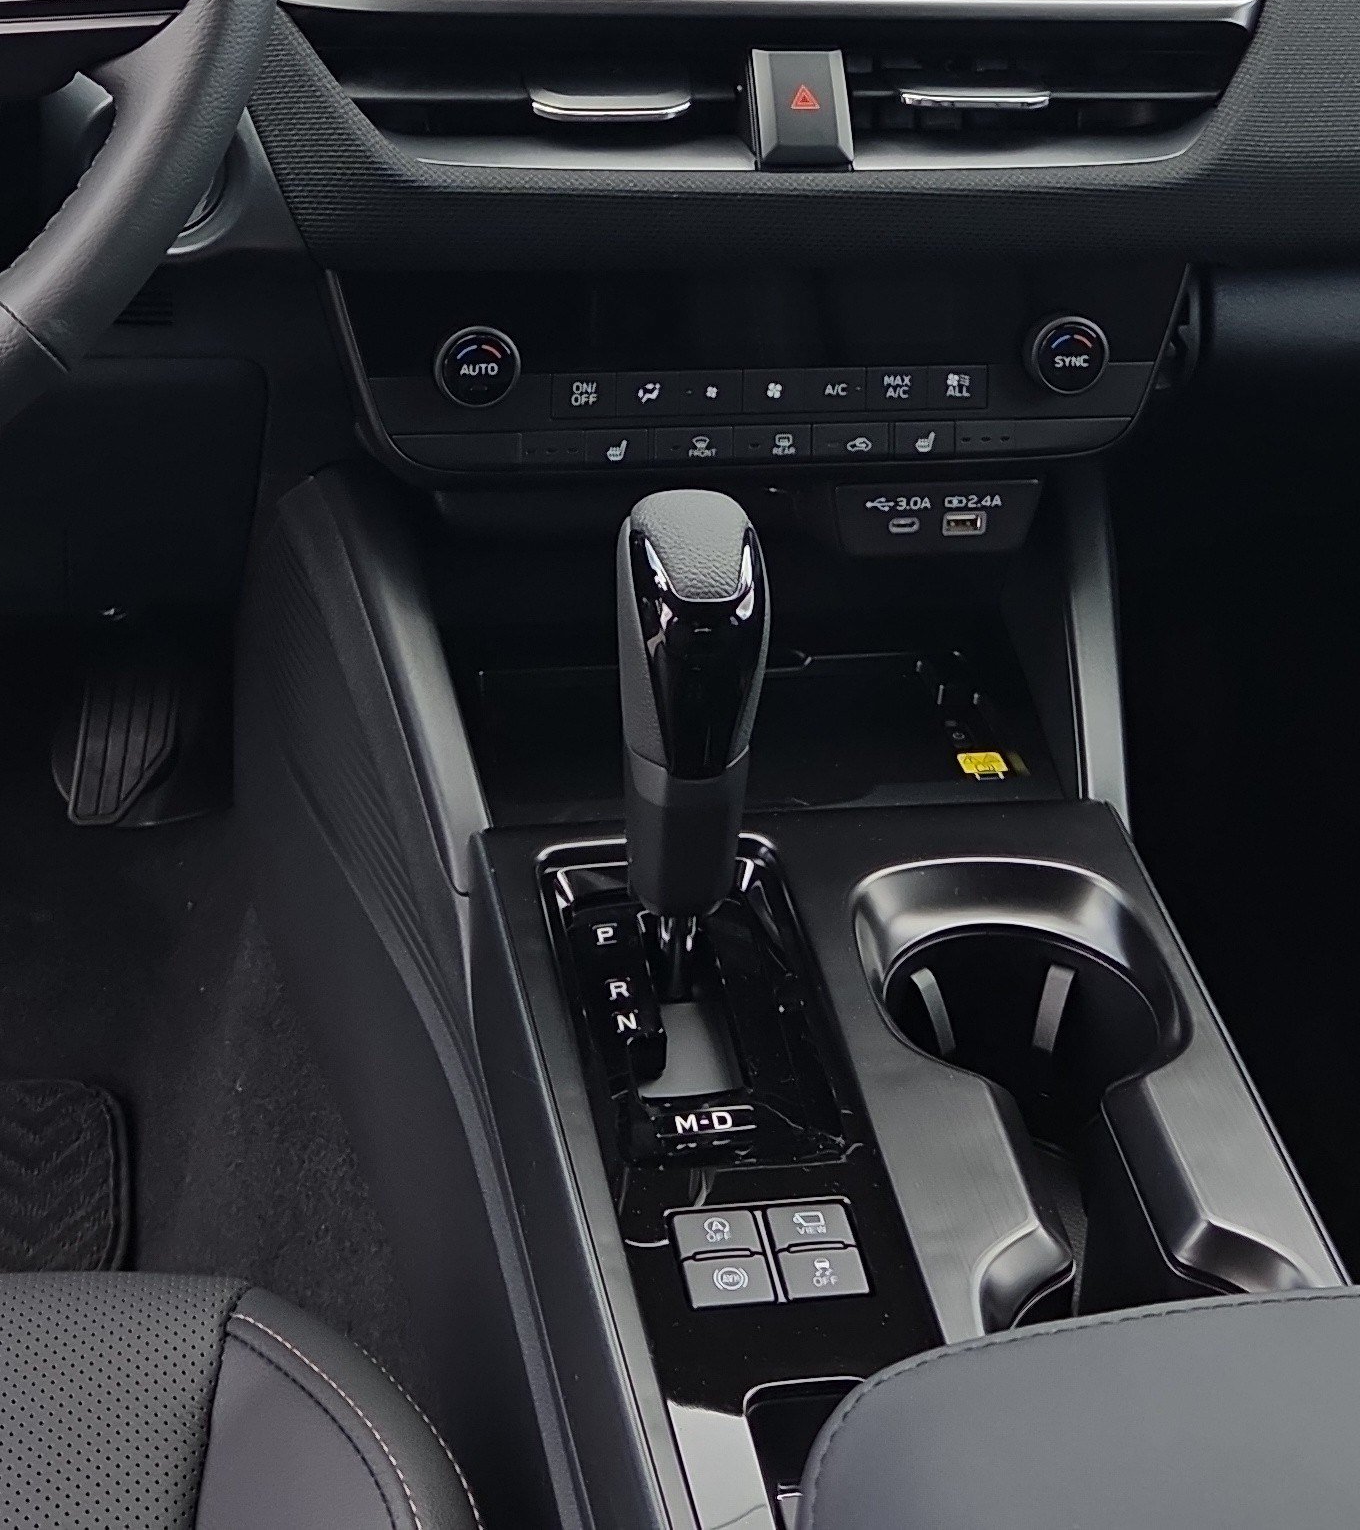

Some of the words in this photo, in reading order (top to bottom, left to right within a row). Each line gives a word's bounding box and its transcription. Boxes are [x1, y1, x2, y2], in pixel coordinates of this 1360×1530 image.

[1054, 355, 1089, 368] SYNC
[460, 363, 499, 376] AUTO
[884, 374, 912, 386] MAX
[572, 381, 597, 394] ON/
[824, 384, 848, 397] A/C
[886, 386, 910, 399] A/C
[946, 386, 971, 398] ALL
[571, 394, 597, 406] OFF
[688, 448, 717, 459] FRONT
[772, 447, 796, 456] REAR
[896, 497, 931, 510] 3.0A
[968, 495, 1002, 508] 2.4A
[596, 926, 614, 943] P
[609, 980, 630, 1000] R
[616, 1012, 638, 1032] N
[796, 1225, 827, 1235] VIEW
[706, 1233, 731, 1243] OFF
[812, 1275, 839, 1288] OFF
